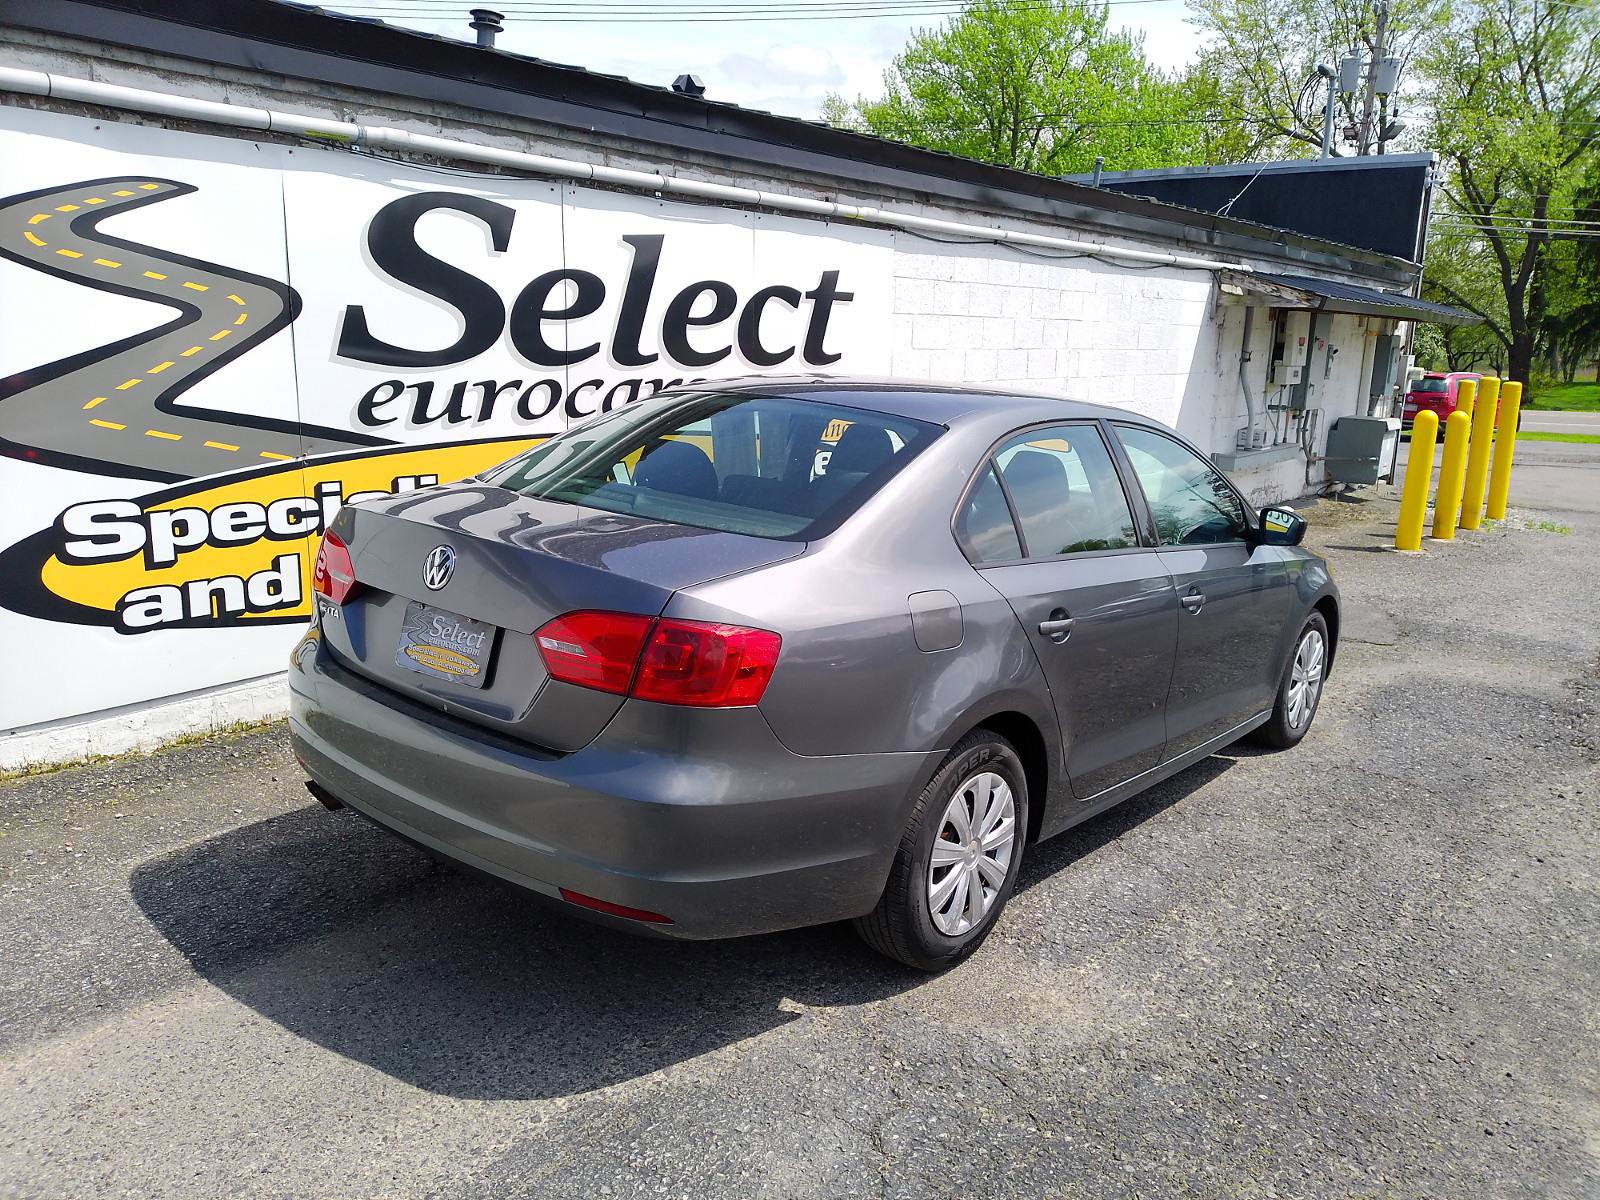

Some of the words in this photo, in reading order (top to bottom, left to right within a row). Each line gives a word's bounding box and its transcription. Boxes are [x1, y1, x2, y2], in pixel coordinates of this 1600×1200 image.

[337, 191, 854, 368] Select
[355, 377, 707, 427] eurocar
[118, 555, 301, 630] and
[429, 615, 486, 649] Select
